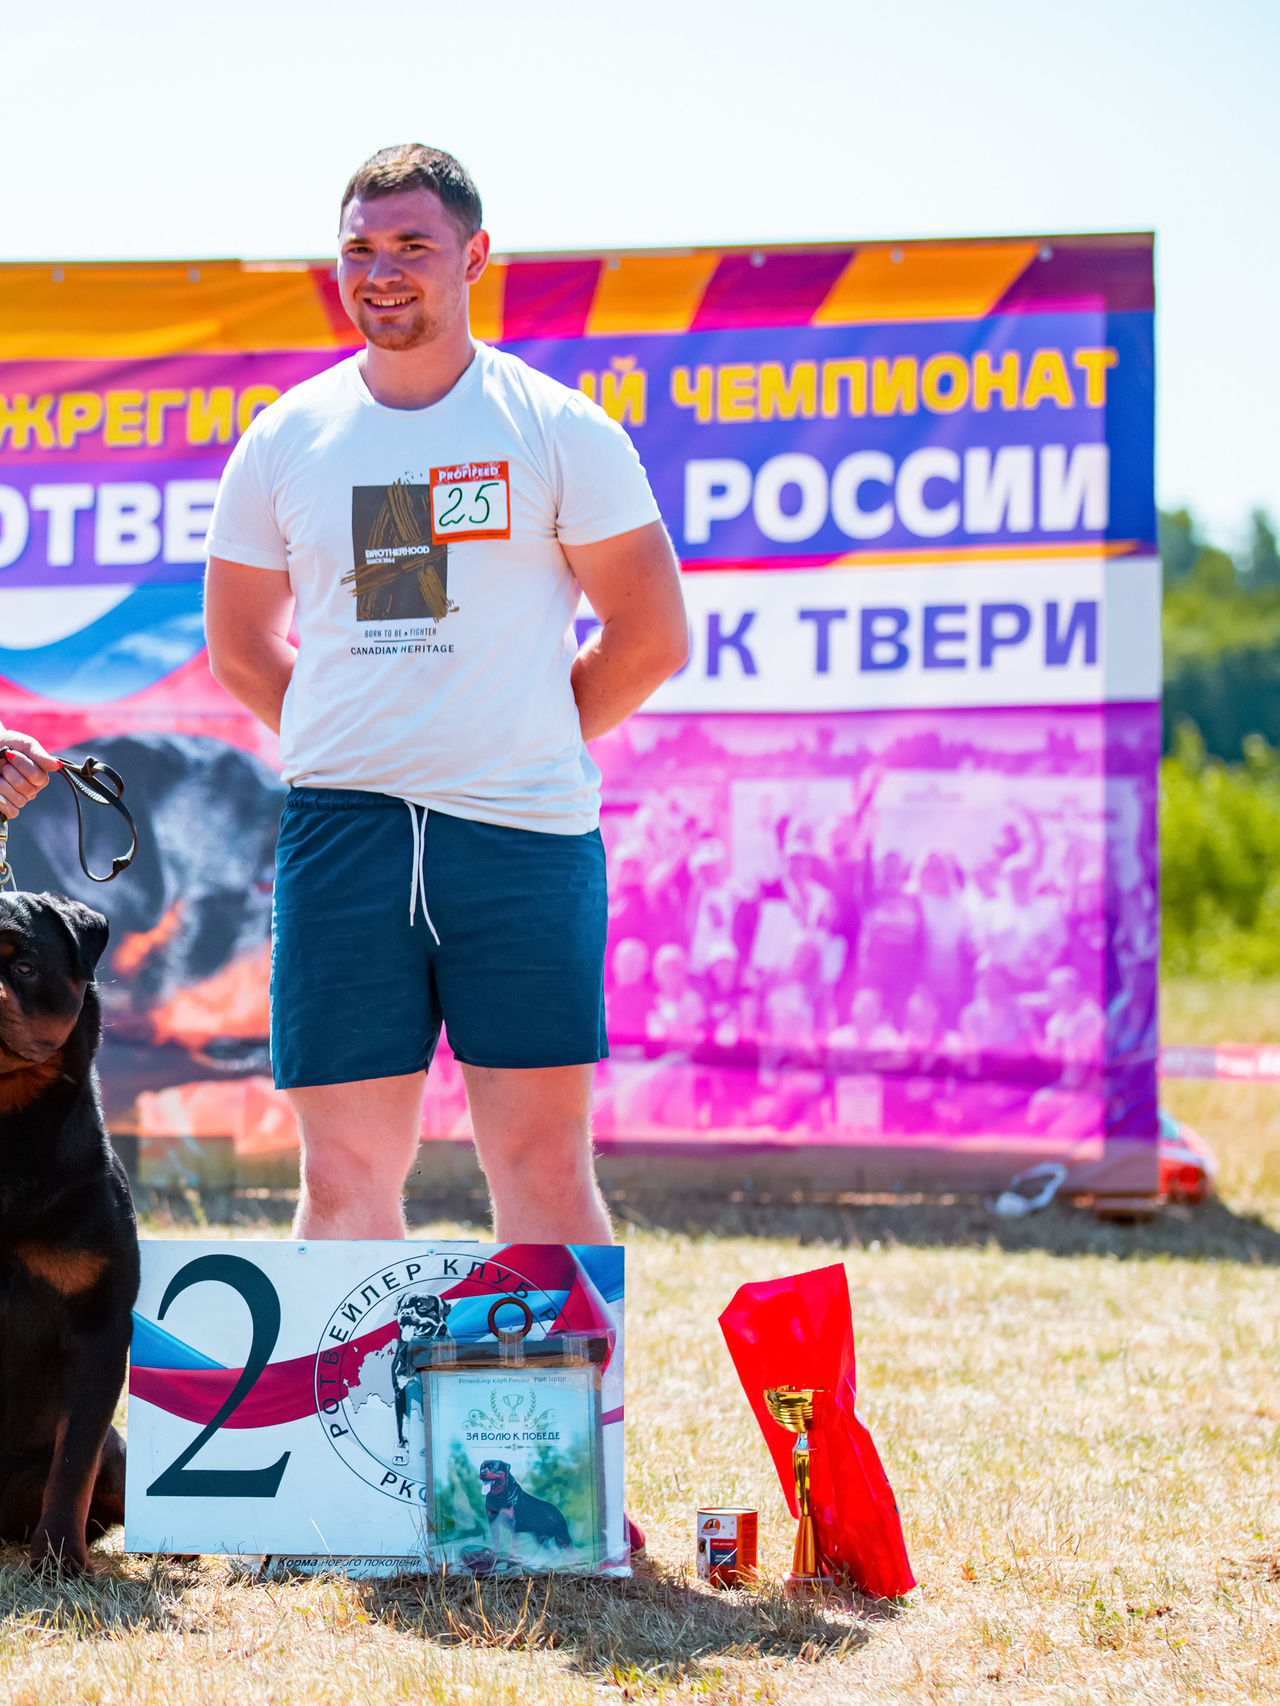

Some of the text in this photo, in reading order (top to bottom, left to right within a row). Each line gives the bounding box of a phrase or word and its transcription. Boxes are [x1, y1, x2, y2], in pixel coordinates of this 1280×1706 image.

[670, 348, 1119, 424] ЧЕМПИОНАТ
[438, 482, 500, 527] 25
[683, 443, 1110, 545] РОССИИ
[365, 545, 430, 558] BROTHERHOOD
[350, 644, 455, 655] CANADIAN HERITAGE
[364, 629, 382, 638] BORN
[384, 629, 392, 637] TO
[394, 629, 402, 637] BE
[410, 628, 437, 636] FIGHTER
[797, 599, 1099, 676] ТВЕРИ
[319, 1263, 422, 1439] РОТВЕЙЛЕР
[443, 1258, 533, 1300] КЛУБ
[146, 1253, 291, 1497] 2
[466, 1431, 561, 1441] ЗА ВОЛЮ К ПОБЕДЕ
[277, 1557, 318, 1567] Корма
[320, 1557, 362, 1567] нового
